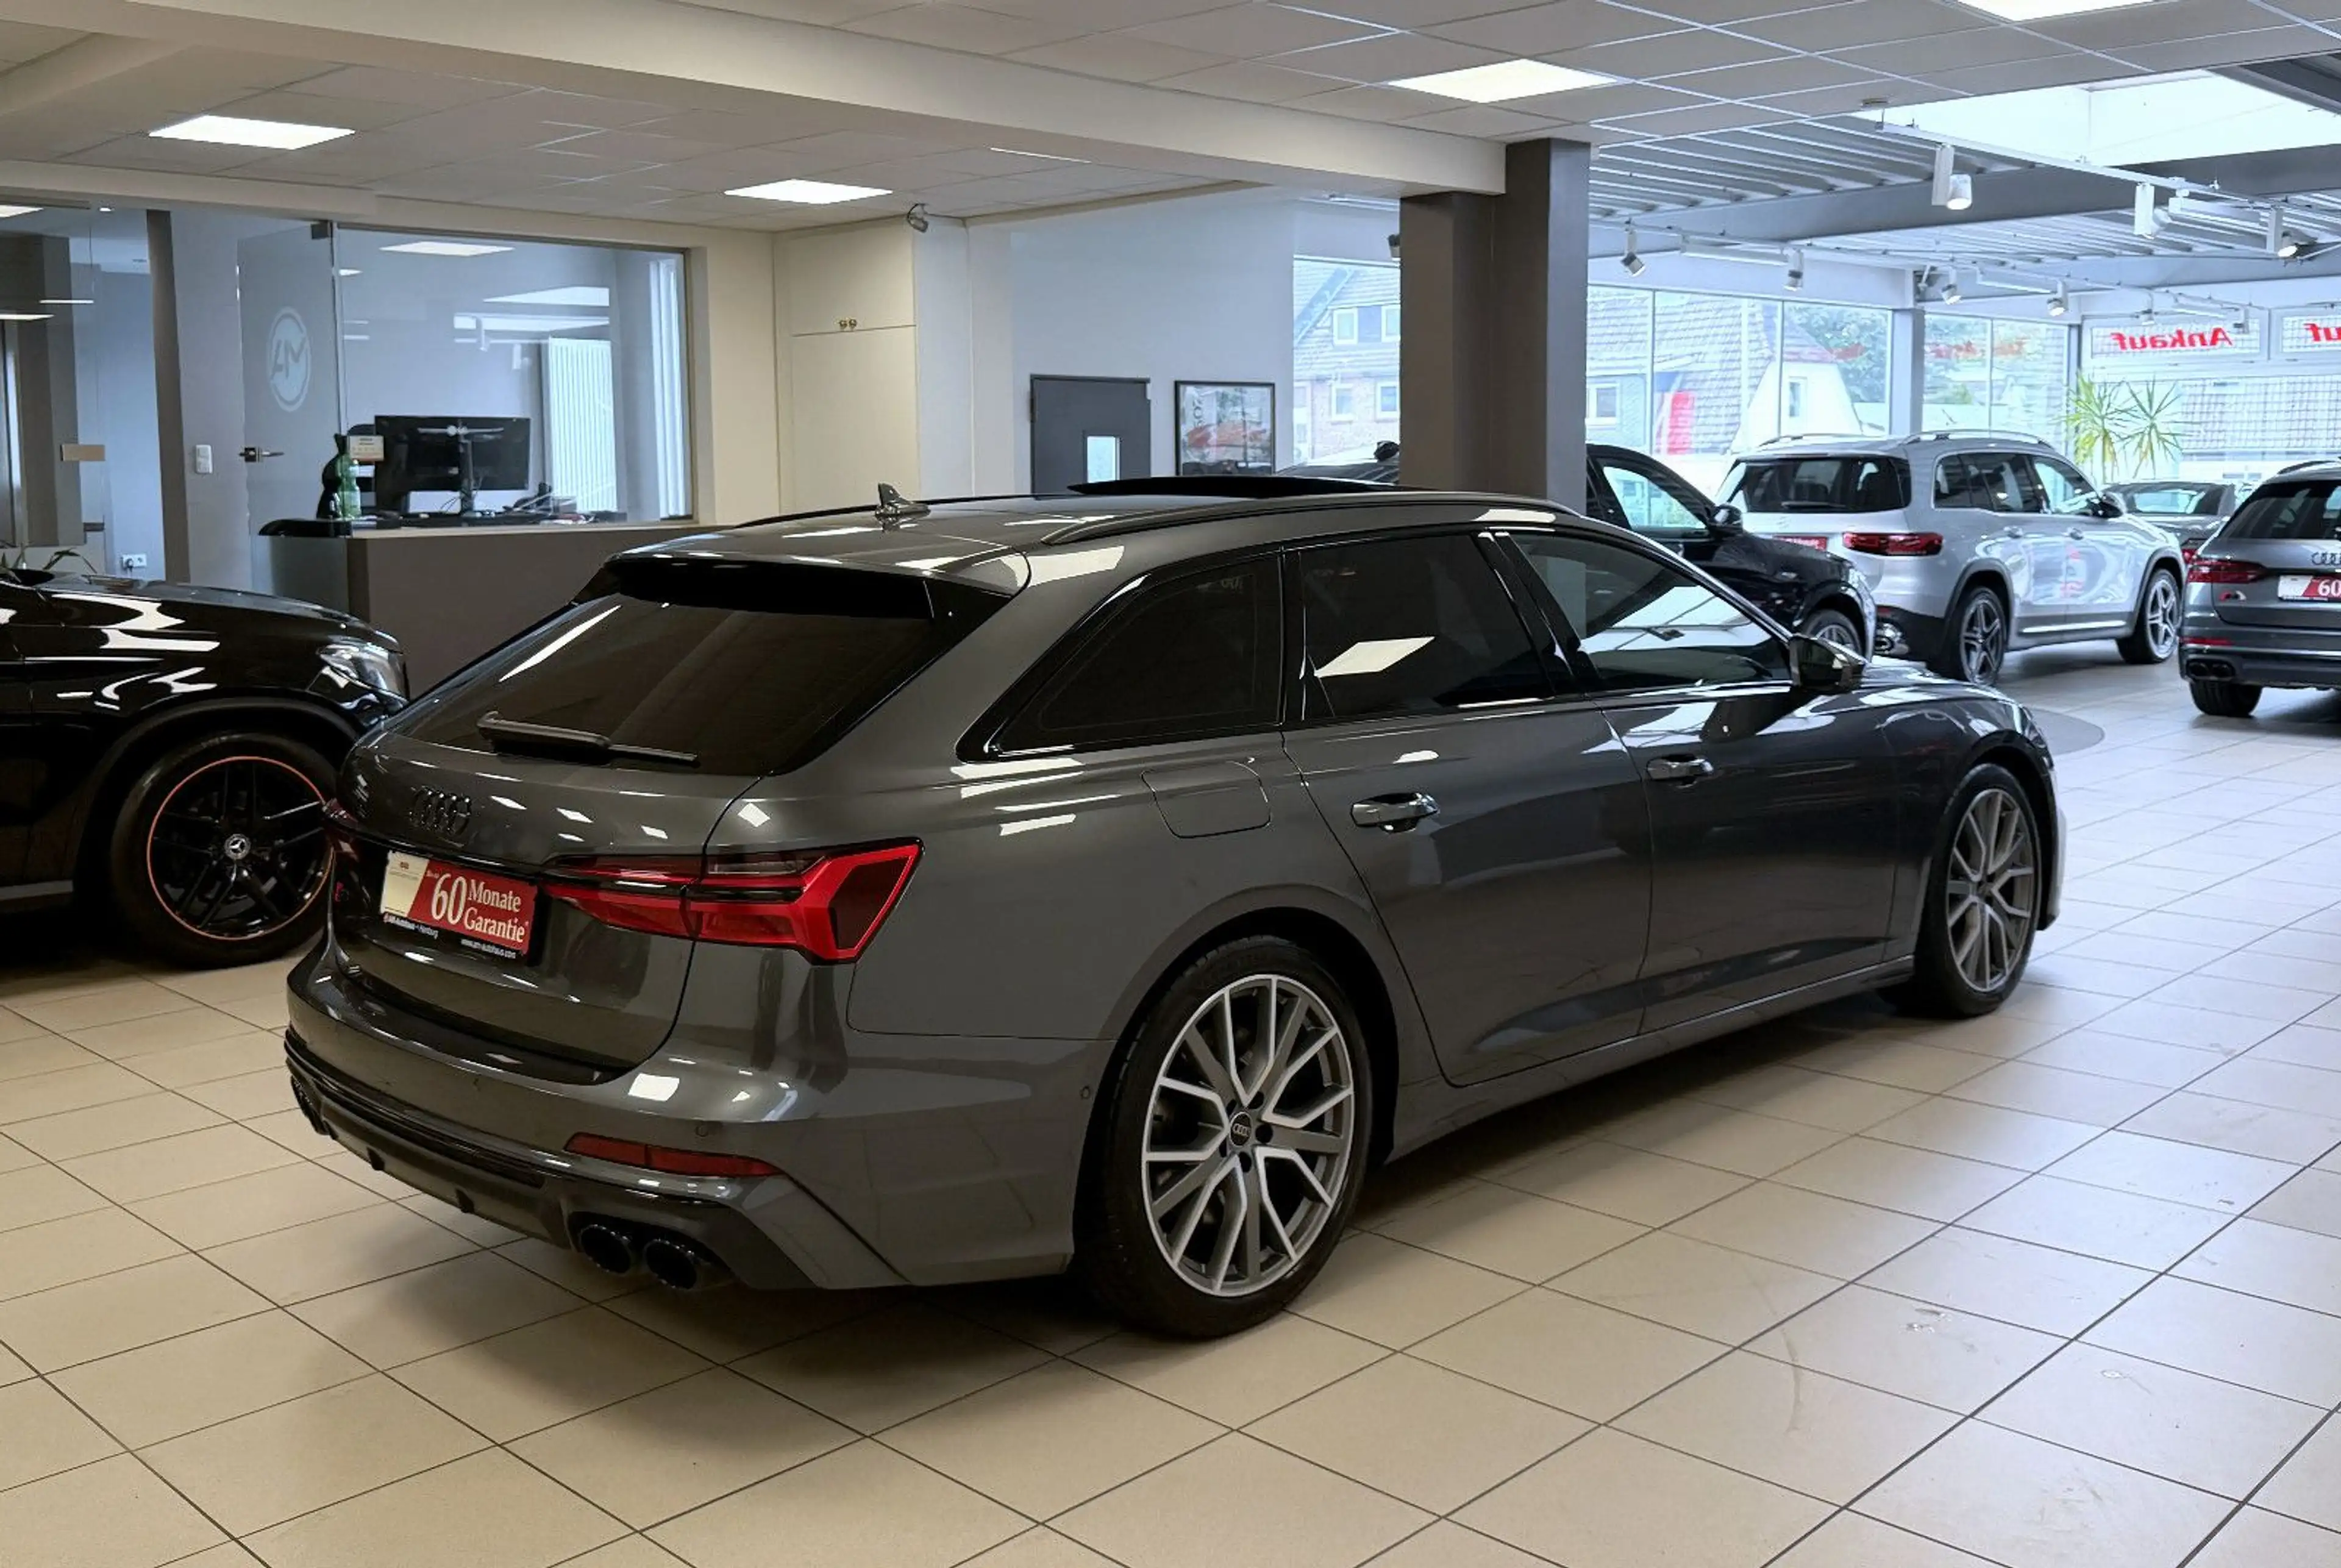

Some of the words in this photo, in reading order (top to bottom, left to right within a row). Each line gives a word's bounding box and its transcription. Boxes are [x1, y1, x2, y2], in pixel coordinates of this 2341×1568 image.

[2318, 580, 2341, 596] 60
[431, 873, 468, 925] 60
[468, 879, 522, 912] Monate
